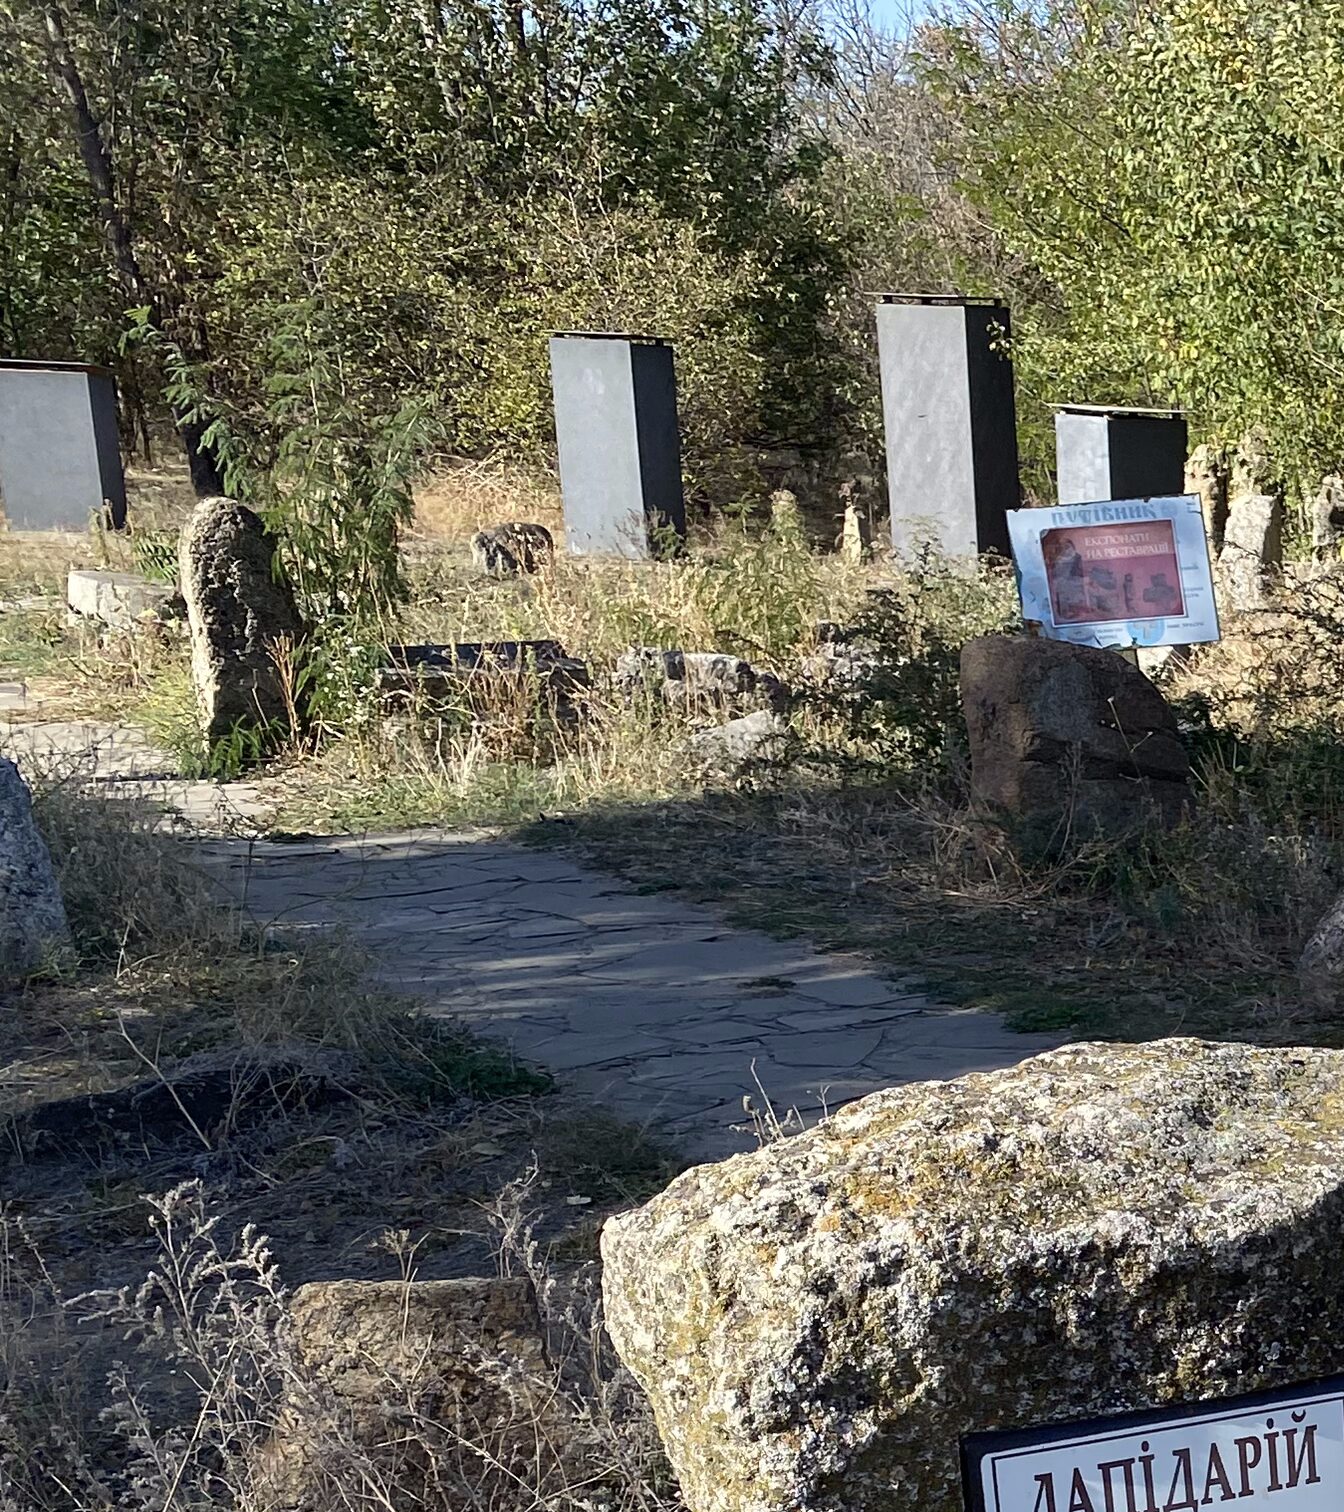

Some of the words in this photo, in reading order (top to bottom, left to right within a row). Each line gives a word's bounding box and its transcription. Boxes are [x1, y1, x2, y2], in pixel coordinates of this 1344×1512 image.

[1084, 532, 1149, 546] ЕКСПОНАТИ
[1086, 548, 1103, 559] НА
[1103, 542, 1168, 558] РЕСТАВРАЦІЇ
